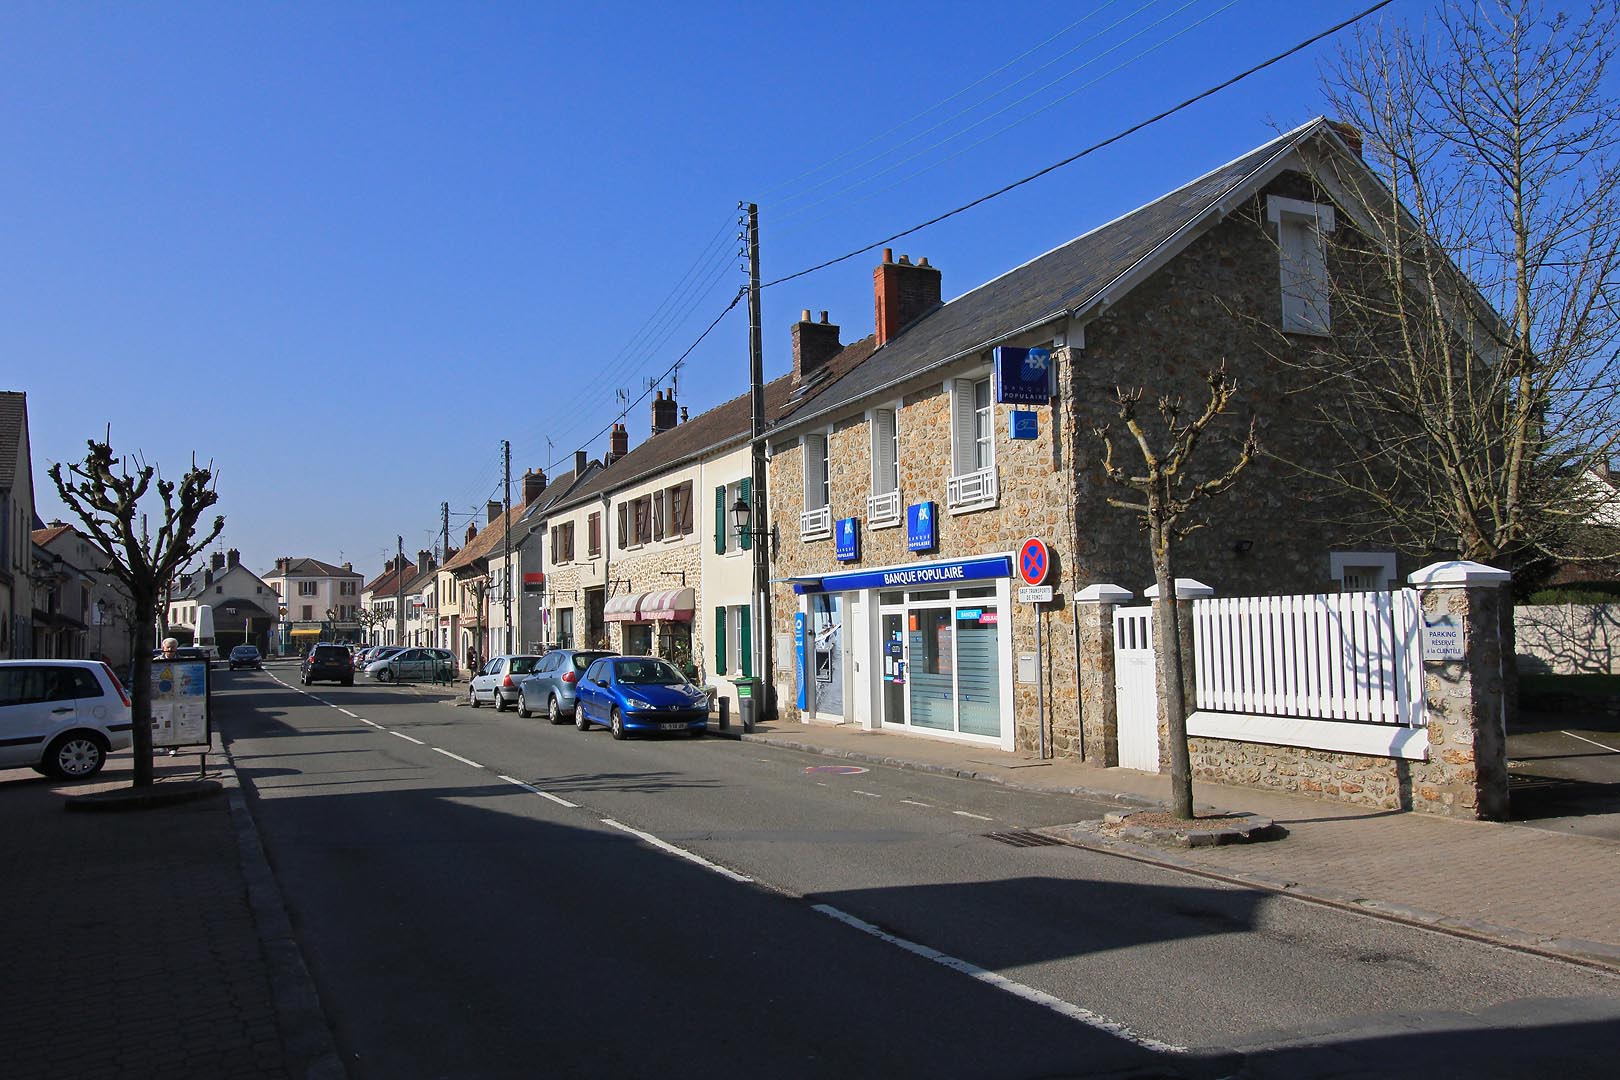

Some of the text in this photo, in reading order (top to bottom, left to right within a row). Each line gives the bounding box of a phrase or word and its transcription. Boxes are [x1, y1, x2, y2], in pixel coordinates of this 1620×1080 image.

[1004, 392, 1047, 401] POPULAIRE
[908, 540, 930, 548] POPULAIRE
[884, 566, 964, 585] BANQUE POPULAIRE
